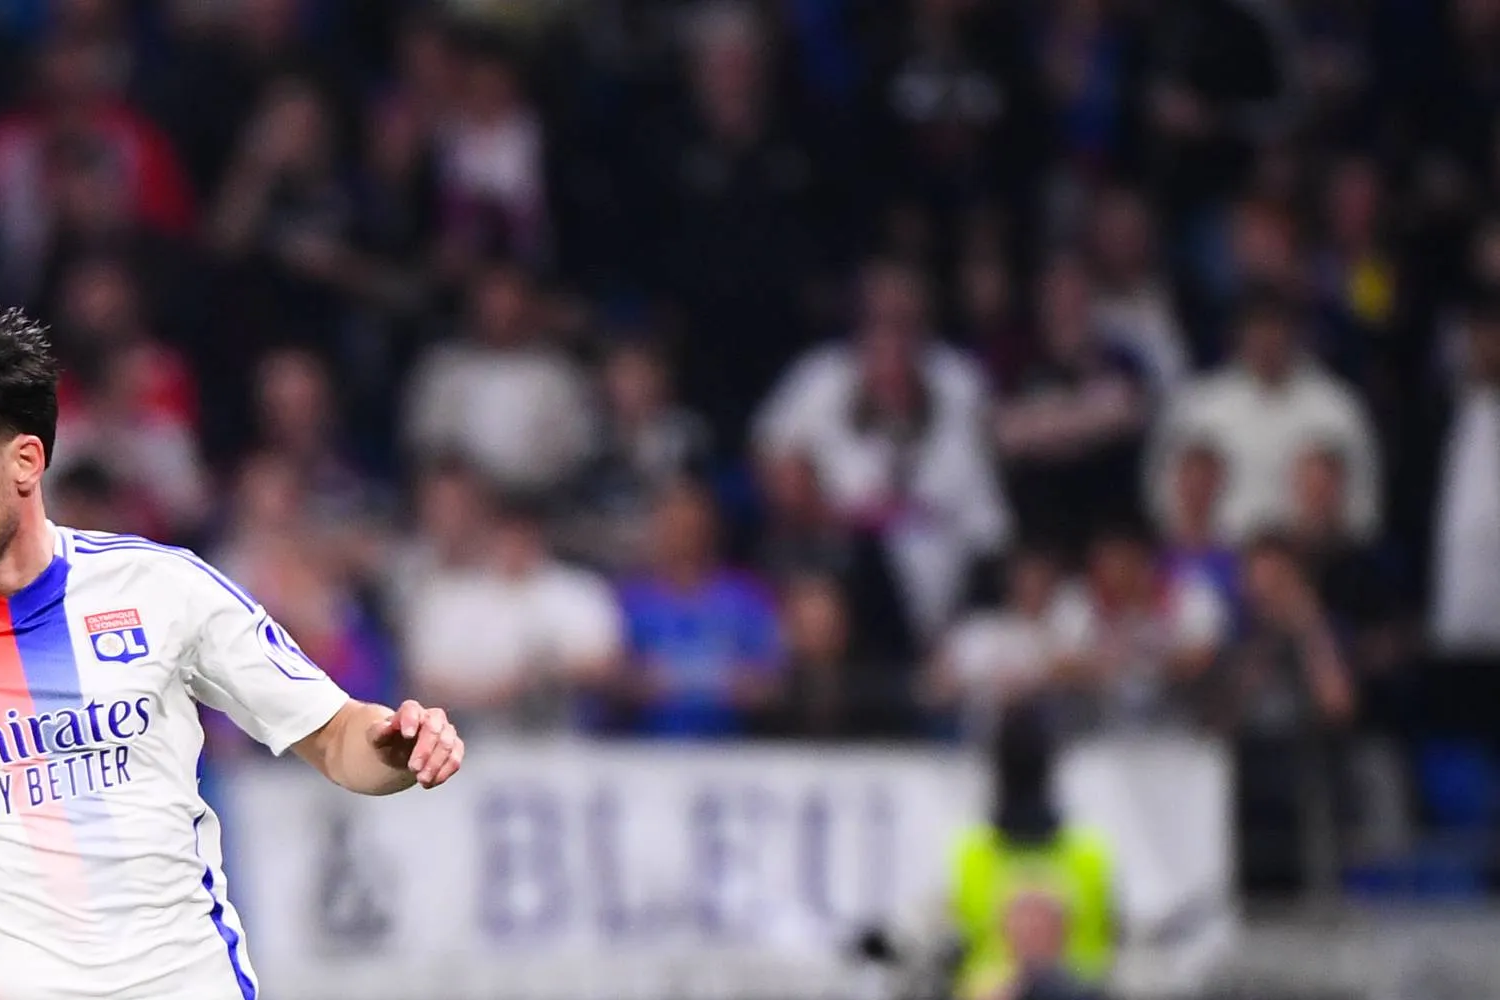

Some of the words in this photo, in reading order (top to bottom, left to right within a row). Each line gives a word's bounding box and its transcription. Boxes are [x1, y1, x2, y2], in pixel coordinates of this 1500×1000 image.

[96, 629, 147, 658] OL
[27, 745, 132, 807] BETTER
[479, 780, 892, 940] BLEU
